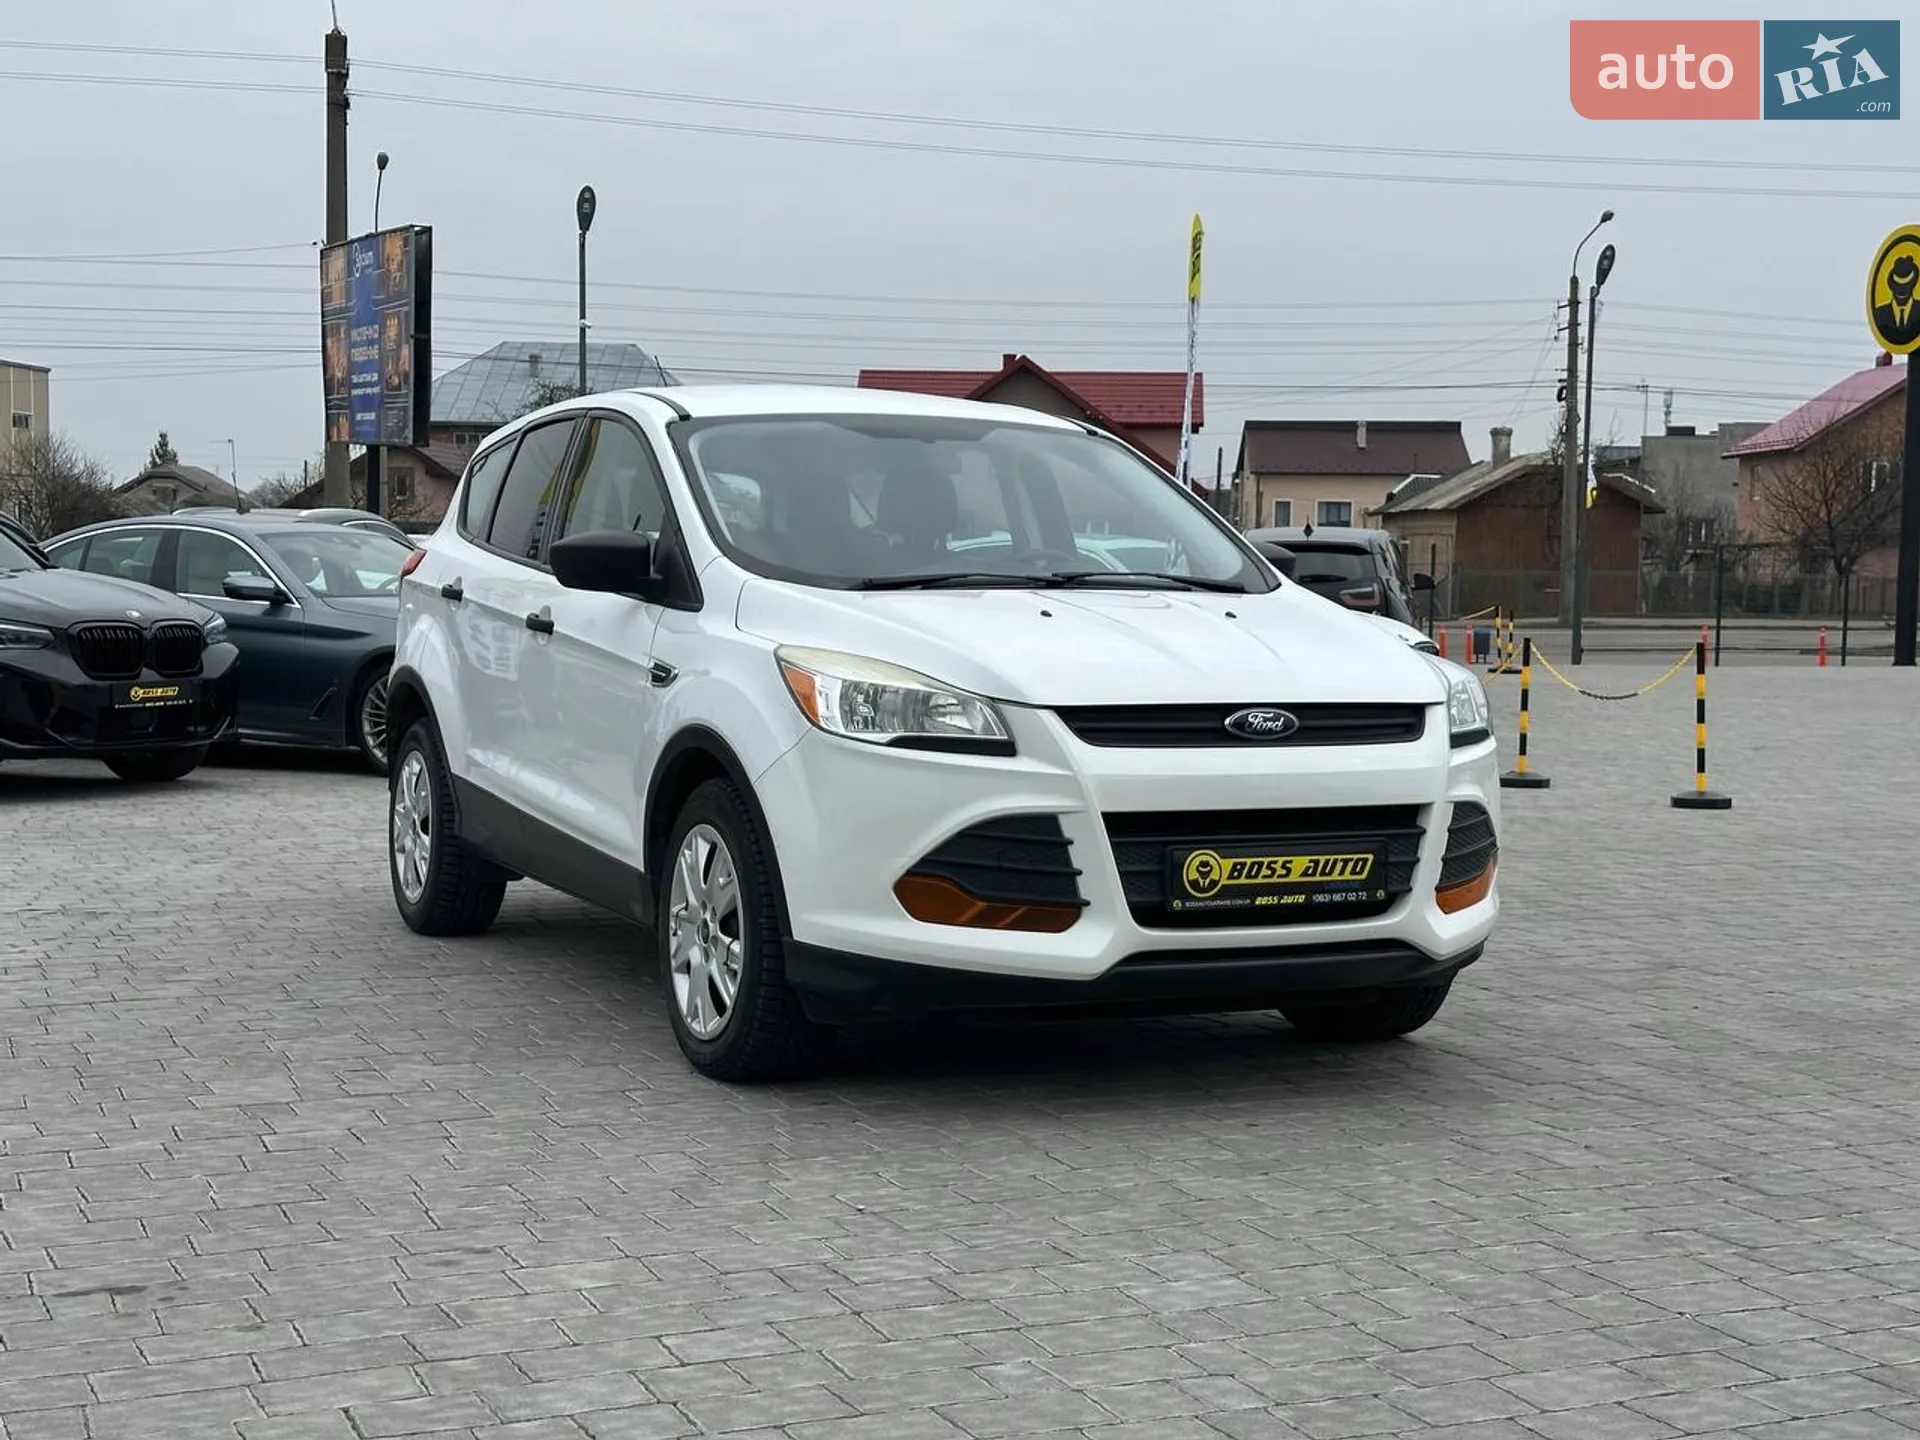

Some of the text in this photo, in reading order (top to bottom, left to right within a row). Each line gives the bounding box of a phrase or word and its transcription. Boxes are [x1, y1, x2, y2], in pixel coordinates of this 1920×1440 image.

[1246, 712, 1285, 732] Ford
[1226, 857, 1370, 881] BOSS AUTO
[1255, 895, 1279, 905] BOSS
[1280, 894, 1306, 904] AUTO
